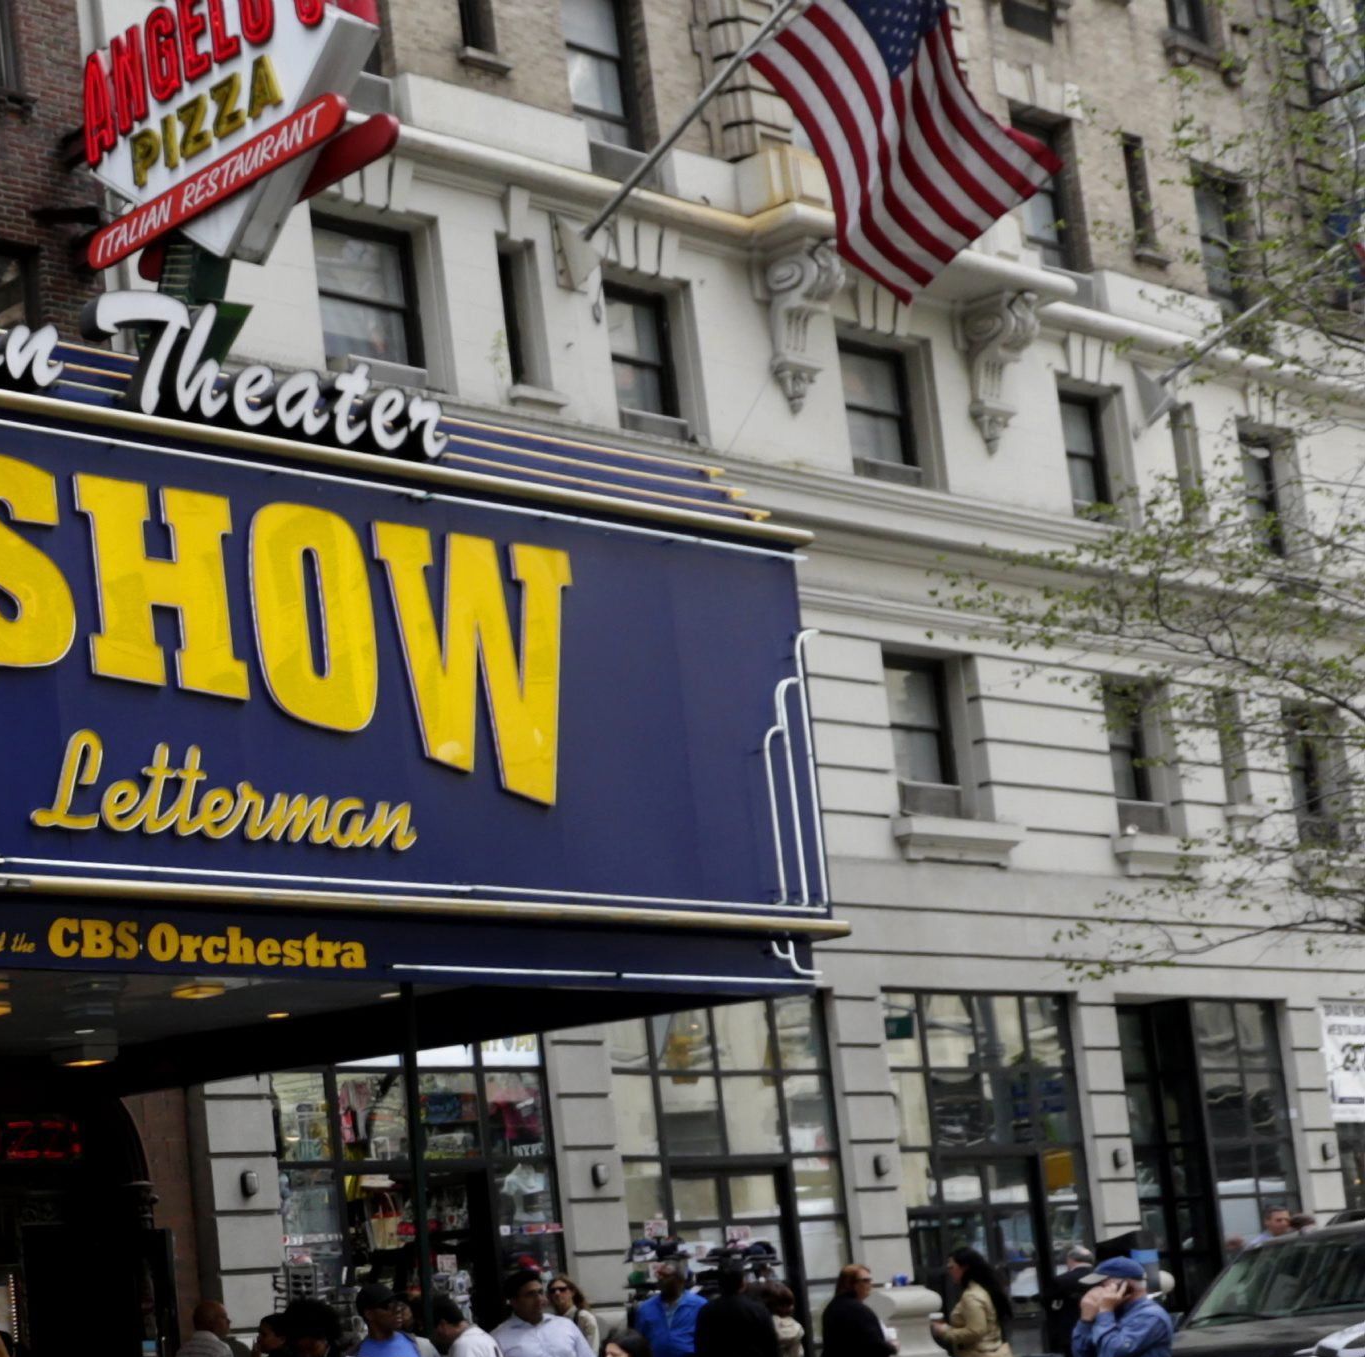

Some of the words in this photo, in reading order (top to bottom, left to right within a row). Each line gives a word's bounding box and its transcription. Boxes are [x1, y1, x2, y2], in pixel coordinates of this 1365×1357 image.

[96, 197, 173, 263] ITALIAN
[180, 102, 327, 214] RESTAURANT
[130, 54, 283, 188] PIZZA
[96, 289, 449, 460] Theater
[30, 727, 417, 852] Letterman
[9, 932, 36, 954] the
[47, 916, 140, 960] CBS
[145, 922, 367, 969] Orchestra
